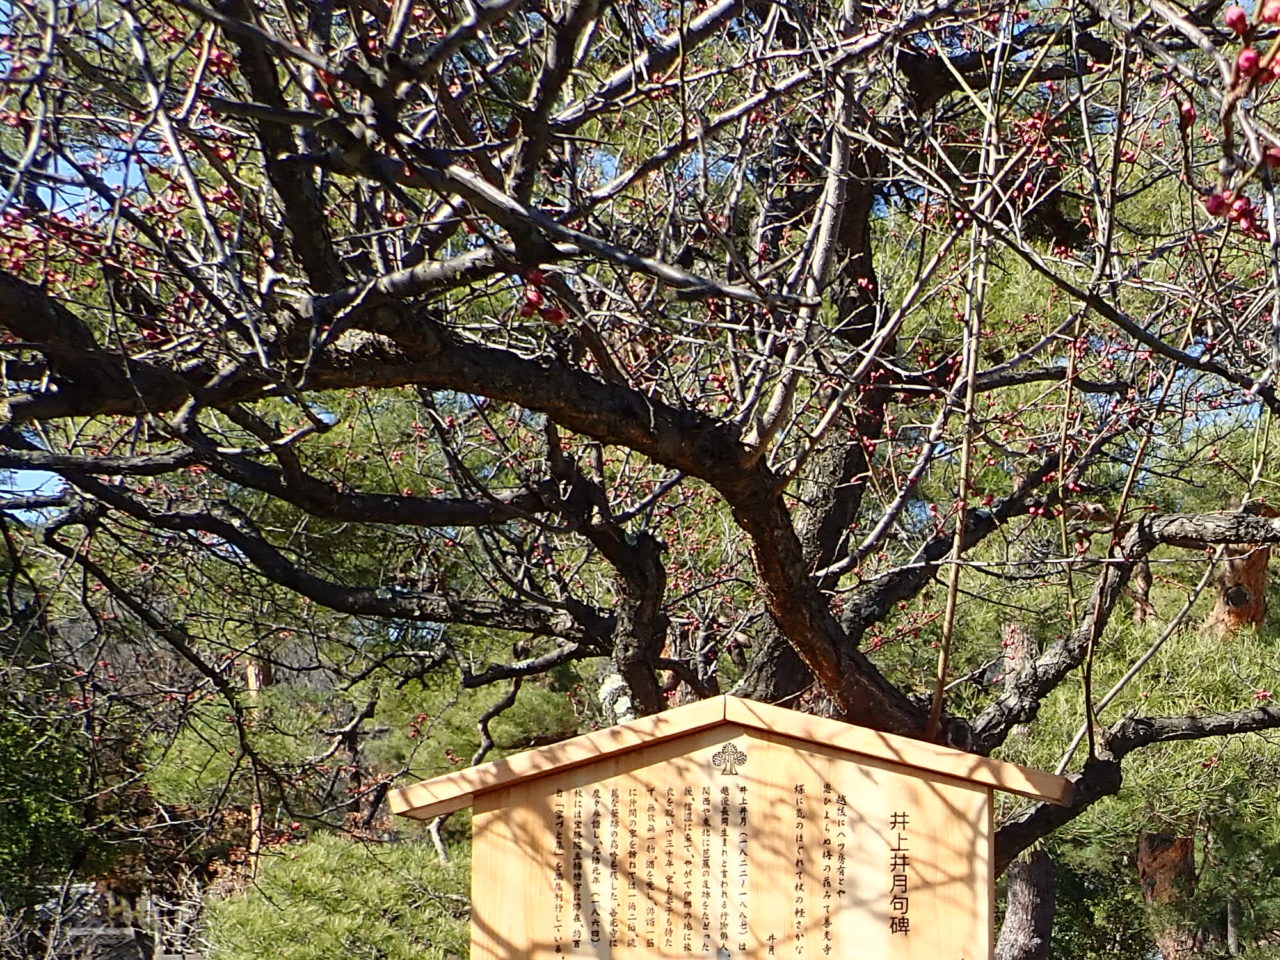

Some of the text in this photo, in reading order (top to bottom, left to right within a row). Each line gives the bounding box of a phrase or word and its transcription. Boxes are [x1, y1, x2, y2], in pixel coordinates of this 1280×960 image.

[889, 811, 910, 936] 井上井月句碑
[766, 933, 777, 956] 井月
